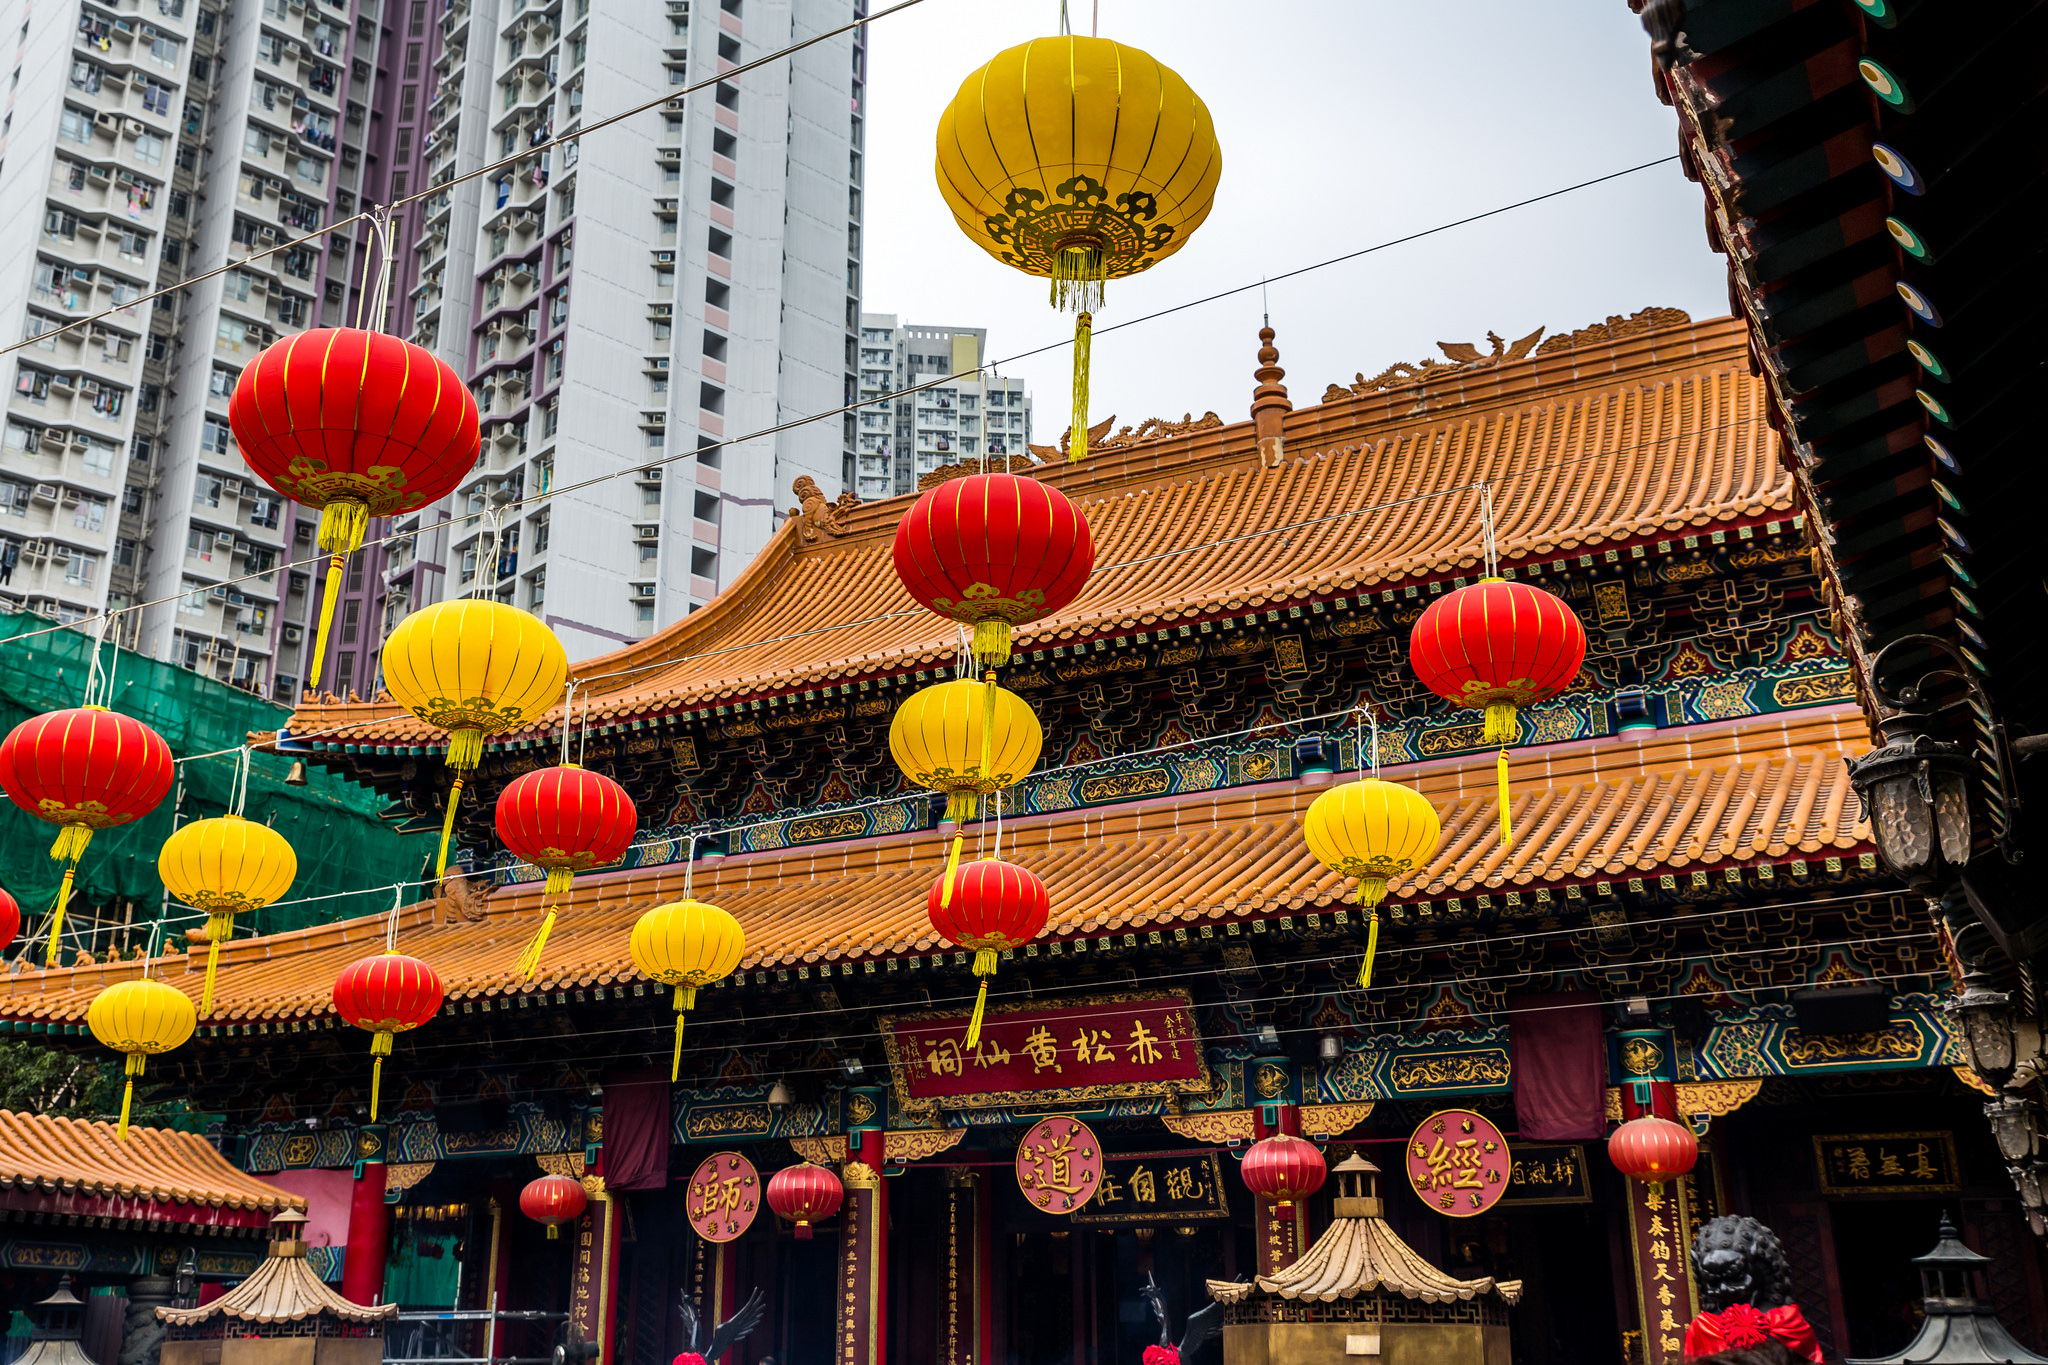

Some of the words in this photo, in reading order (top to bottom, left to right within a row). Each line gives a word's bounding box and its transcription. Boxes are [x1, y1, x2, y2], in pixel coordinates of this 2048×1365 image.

[1033, 1133, 1085, 1195] 道
[1095, 1164, 1204, 1207] 觀自在
[1426, 1135, 1484, 1192] 經
[702, 1171, 742, 1223] 師
